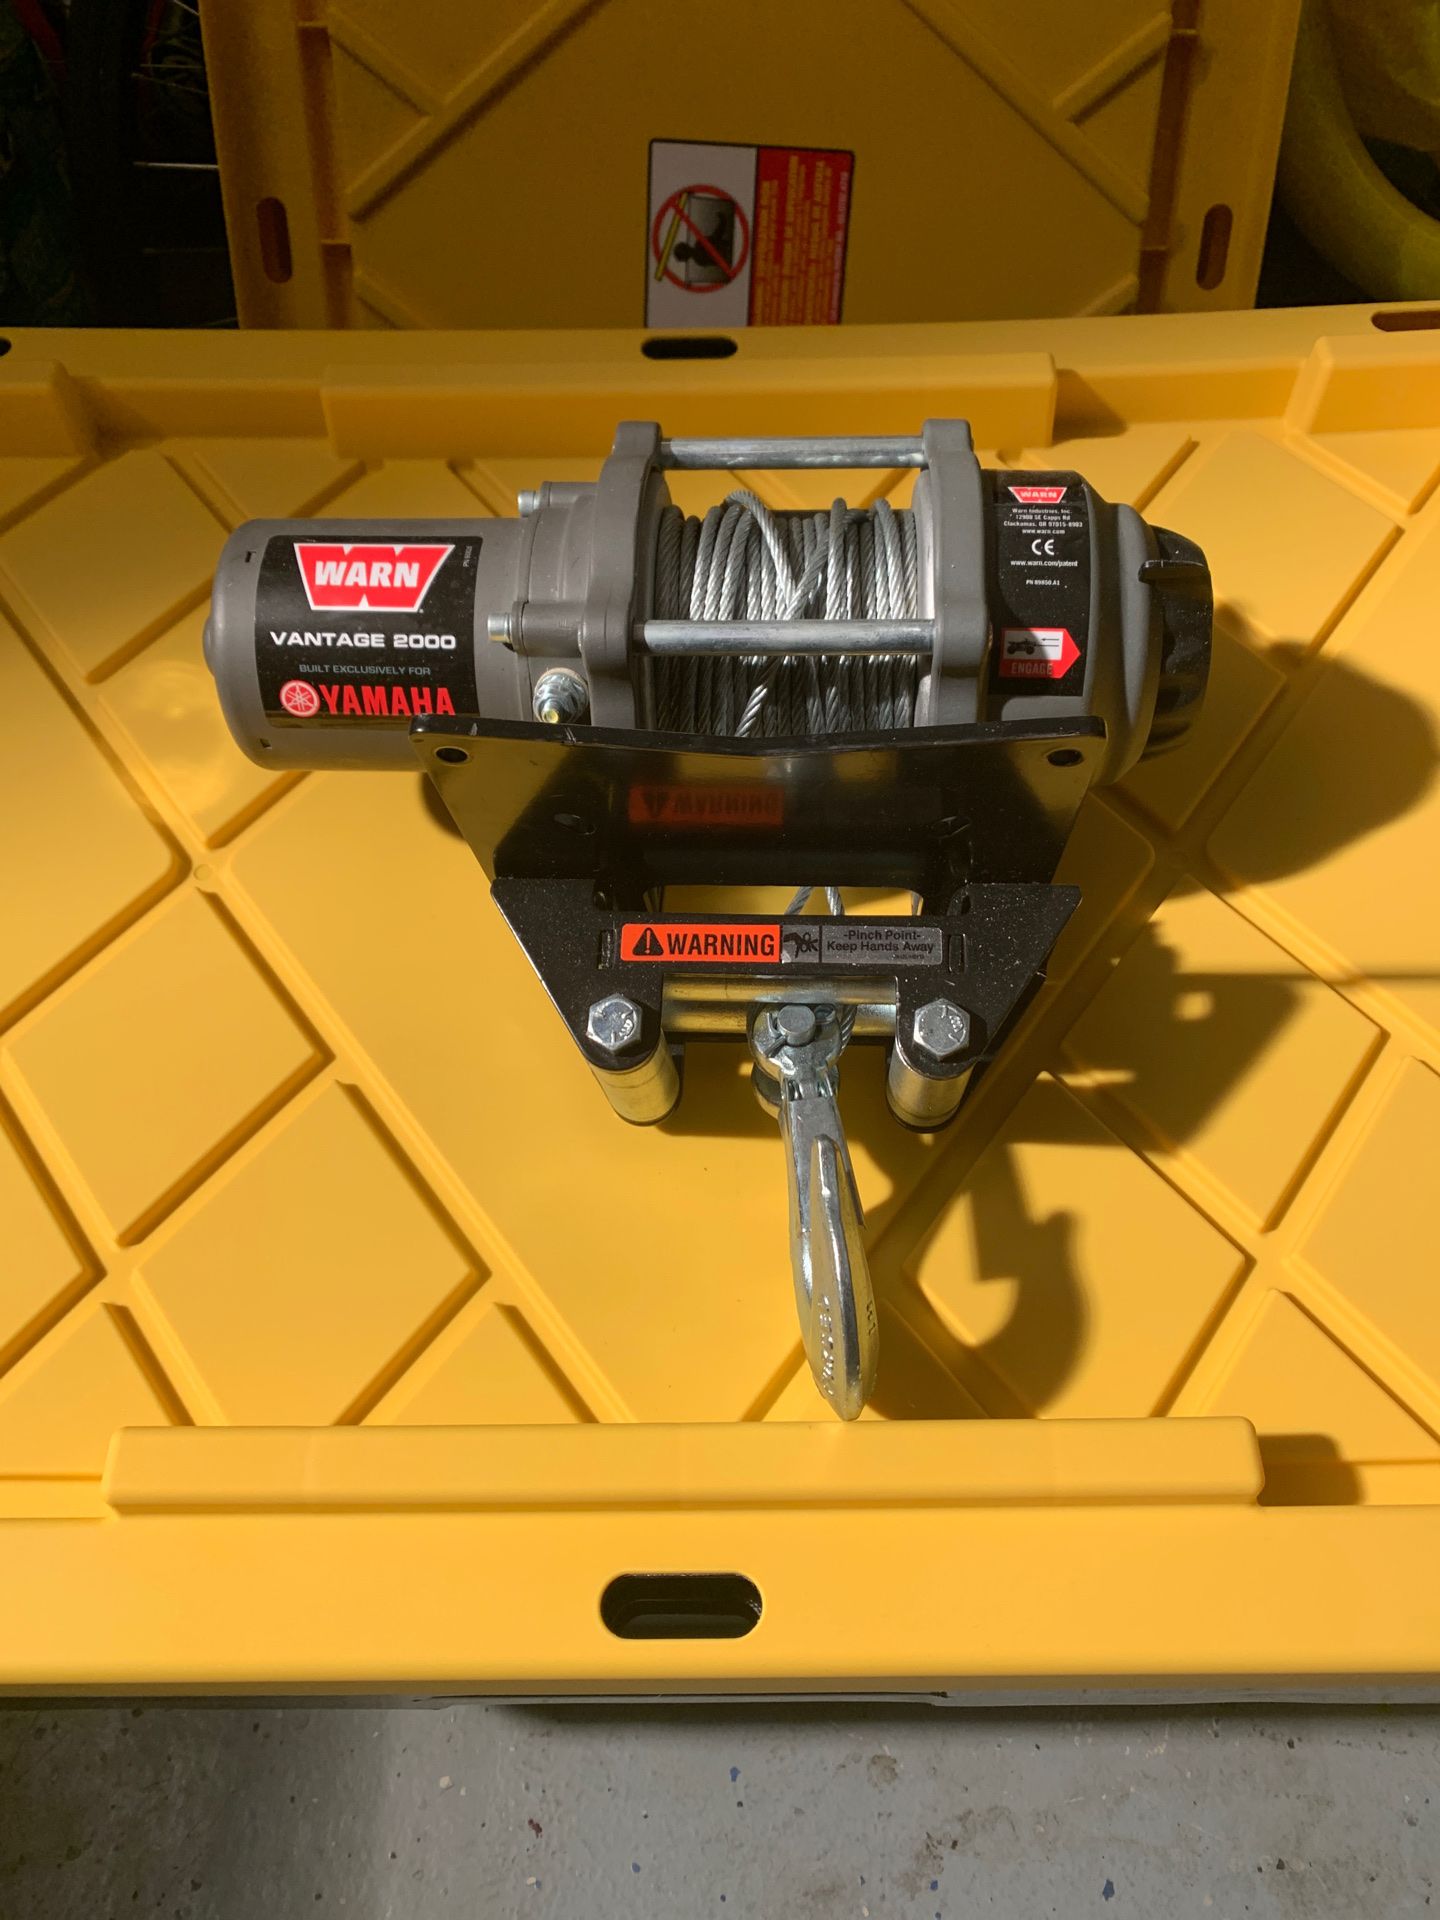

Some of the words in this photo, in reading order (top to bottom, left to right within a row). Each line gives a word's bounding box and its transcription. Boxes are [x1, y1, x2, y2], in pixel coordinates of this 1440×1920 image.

[1031, 538, 1055, 556] CE
[1010, 560, 1078, 568] www.warn.com/patent
[315, 561, 420, 587] WARN
[270, 631, 385, 648] VANTAGE
[393, 634, 456, 650] 2000
[299, 664, 330, 673] BUILT
[333, 665, 406, 675] EXCLUSIVELY
[408, 666, 431, 675] FOR
[1011, 662, 1053, 675] ENGAGE
[318, 684, 456, 716] YAMAHA
[666, 933, 775, 957] WARNING
[827, 941, 858, 953] Keep
[861, 941, 899, 952] Hands
[903, 942, 934, 954] Away
